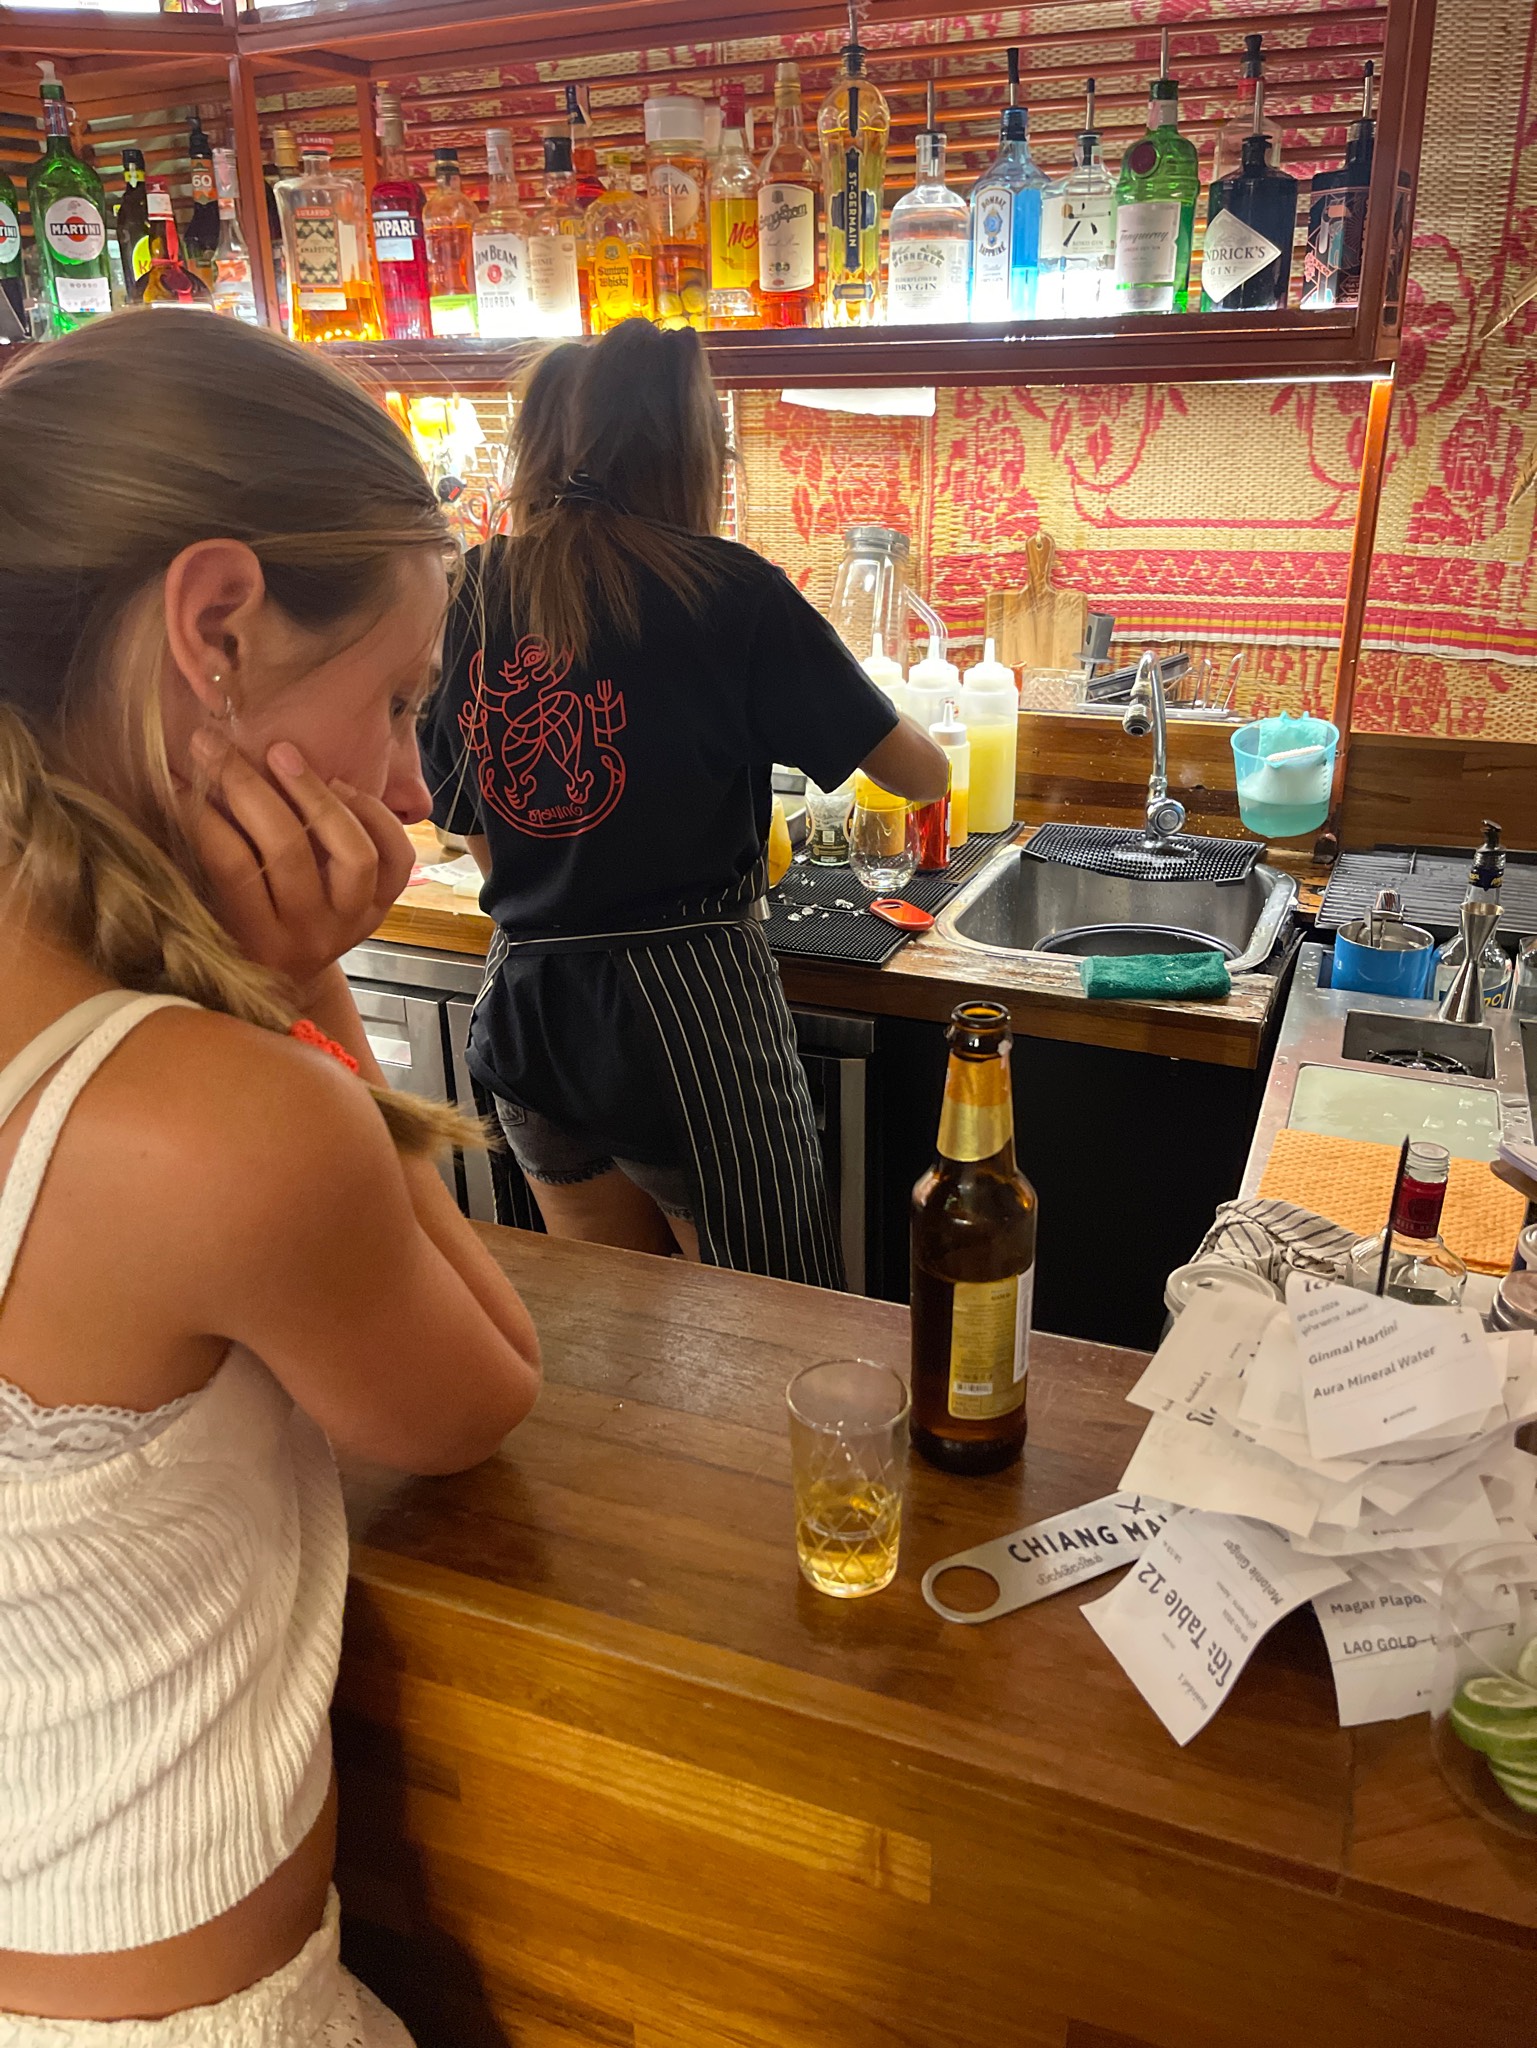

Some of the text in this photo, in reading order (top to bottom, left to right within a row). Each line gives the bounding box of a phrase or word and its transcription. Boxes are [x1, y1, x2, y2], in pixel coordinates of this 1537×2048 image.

[650, 184, 690, 197] CHOYA
[848, 171, 857, 247] ST-GERMAIN
[981, 196, 1007, 212] BOMBAY
[51, 224, 100, 235] MARTINI
[1120, 230, 1169, 244] Tanqueray
[475, 244, 518, 270] JIM BEAM
[979, 241, 1007, 257] SAPPHIRE
[893, 252, 943, 268] WENNEKER
[597, 265, 629, 276] Suntory
[600, 276, 629, 288] Whisky
[895, 283, 912, 291] DRY
[480, 296, 515, 308] BOURBON
[1356, 1319, 1399, 1349] Martini
[1312, 1332, 1472, 1399] Aura Mineral Water 1
[1007, 1525, 1119, 1563] CHIANG
[1222, 1538, 1251, 1570] Ginger
[1137, 1561, 1167, 1595] 12
[1248, 1566, 1285, 1606] Melonie
[1330, 1600, 1376, 1614] Magar
[1379, 1594, 1427, 1608] Plapo
[1164, 1588, 1208, 1650] Table
[1343, 1640, 1373, 1655] LAO
[1376, 1635, 1418, 1652] GOLD
